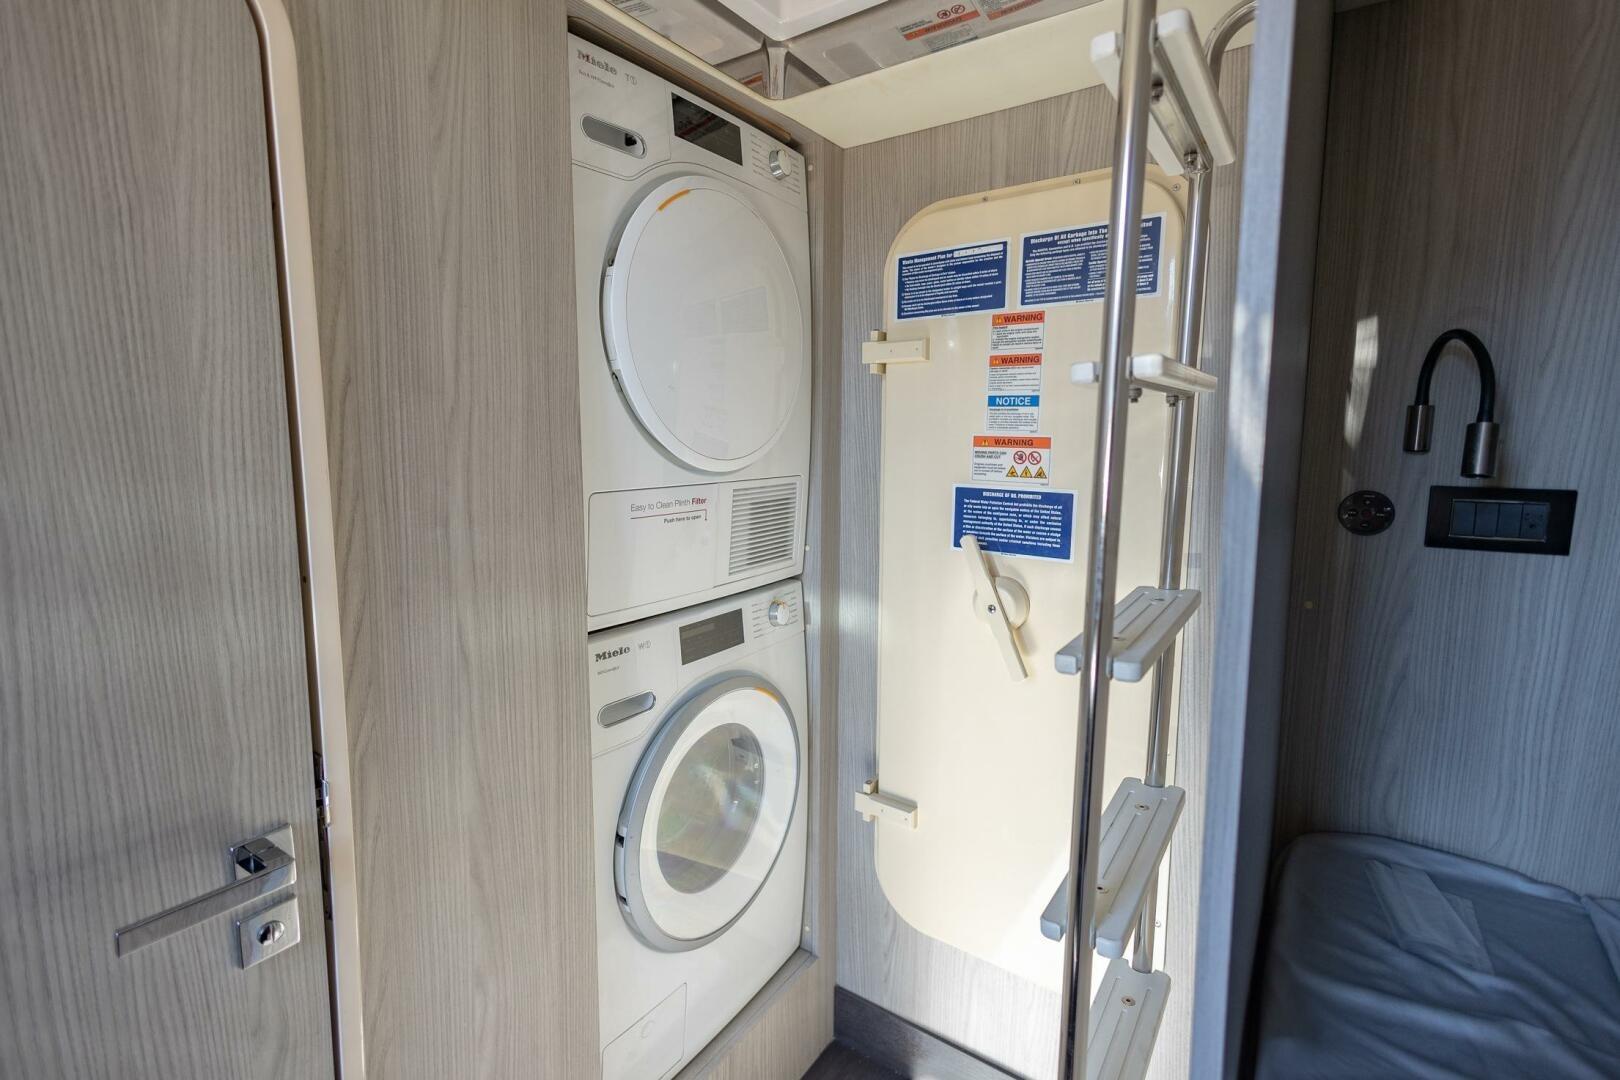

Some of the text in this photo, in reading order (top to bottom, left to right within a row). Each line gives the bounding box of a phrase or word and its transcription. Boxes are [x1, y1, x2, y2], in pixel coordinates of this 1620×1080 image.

[577, 48, 618, 76] Miele
[1030, 236, 1053, 245] Discharge
[1068, 230, 1087, 239] Garbage
[914, 255, 936, 264] Management
[1003, 313, 1043, 323] WARNING
[1001, 355, 1040, 365] WARNING
[995, 396, 1031, 406] NOTICE
[630, 504, 646, 512] Easy
[656, 501, 674, 510] Clean
[595, 646, 630, 662] Miele
